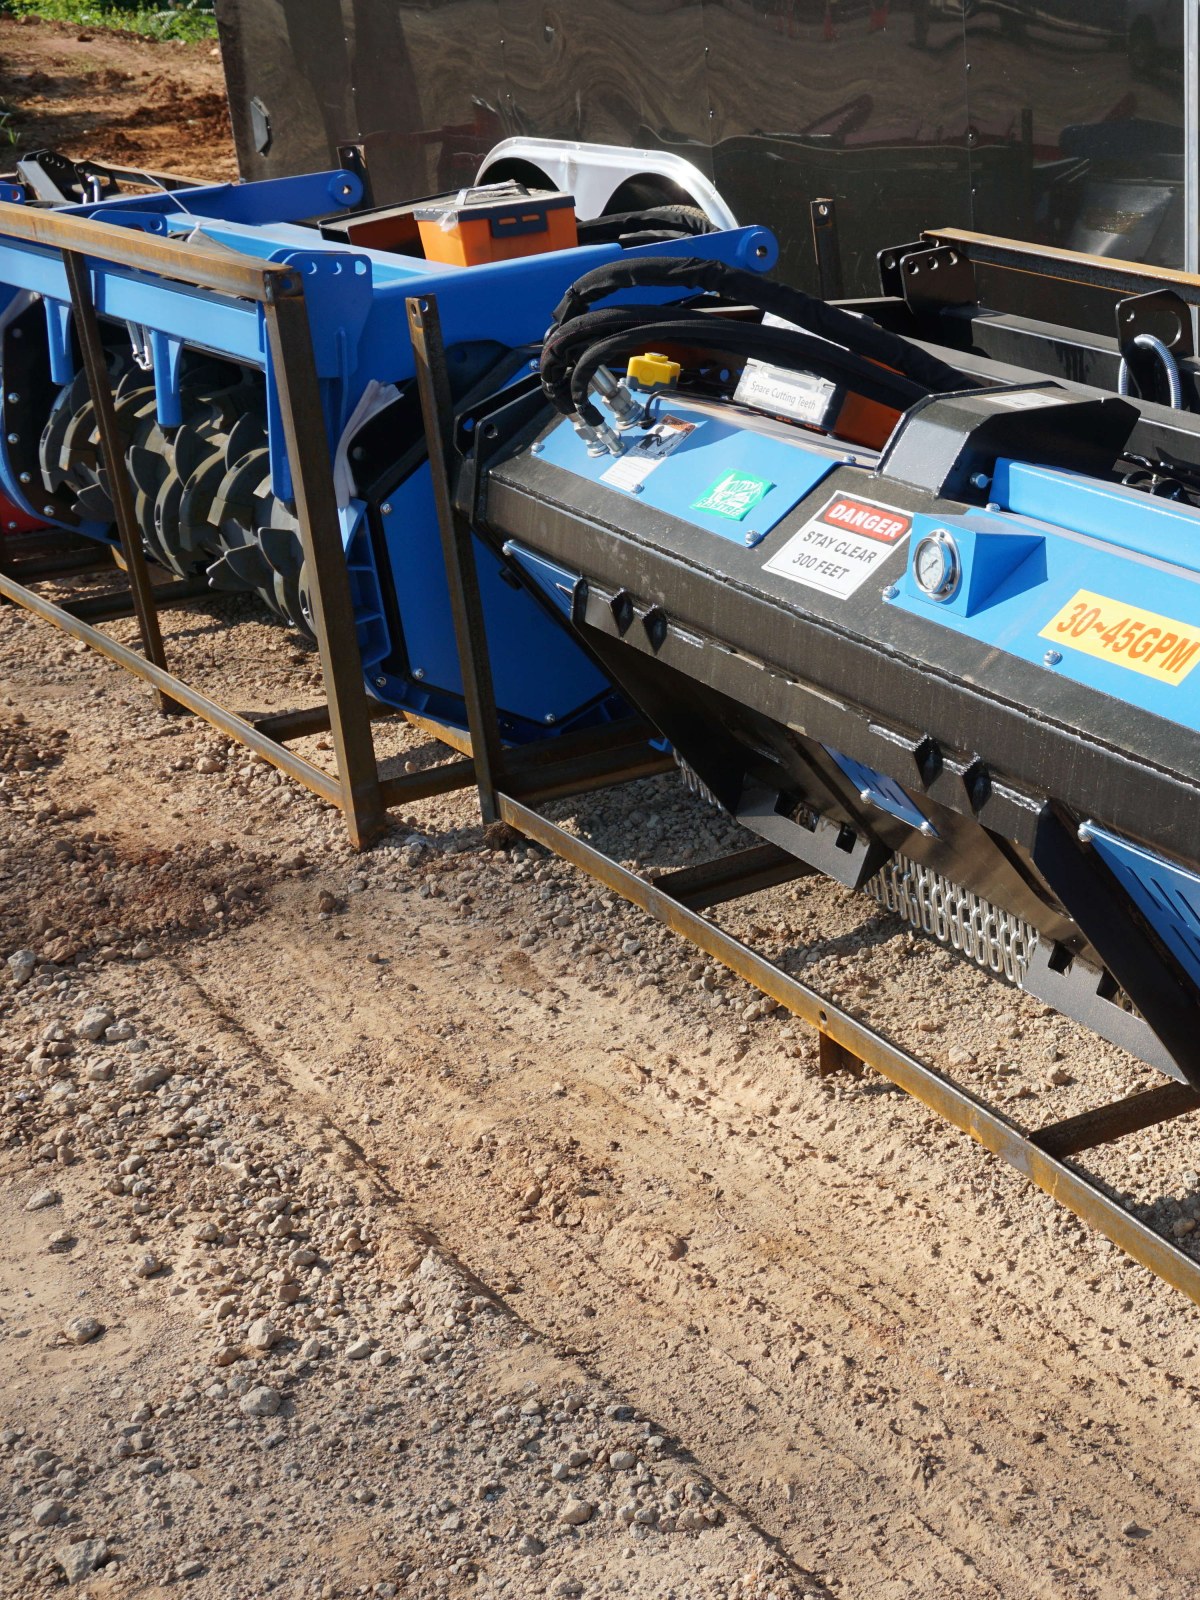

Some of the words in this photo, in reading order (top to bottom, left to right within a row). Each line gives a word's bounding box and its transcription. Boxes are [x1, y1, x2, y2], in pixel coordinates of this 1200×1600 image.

[750, 380, 769, 396] Spare
[771, 388, 797, 407] Cutting
[797, 396, 817, 410] Teeth
[828, 503, 903, 538] DANGER
[803, 531, 837, 549] STAY
[834, 543, 878, 564] CLEAR
[792, 552, 818, 569] 300
[814, 561, 850, 580] FEET
